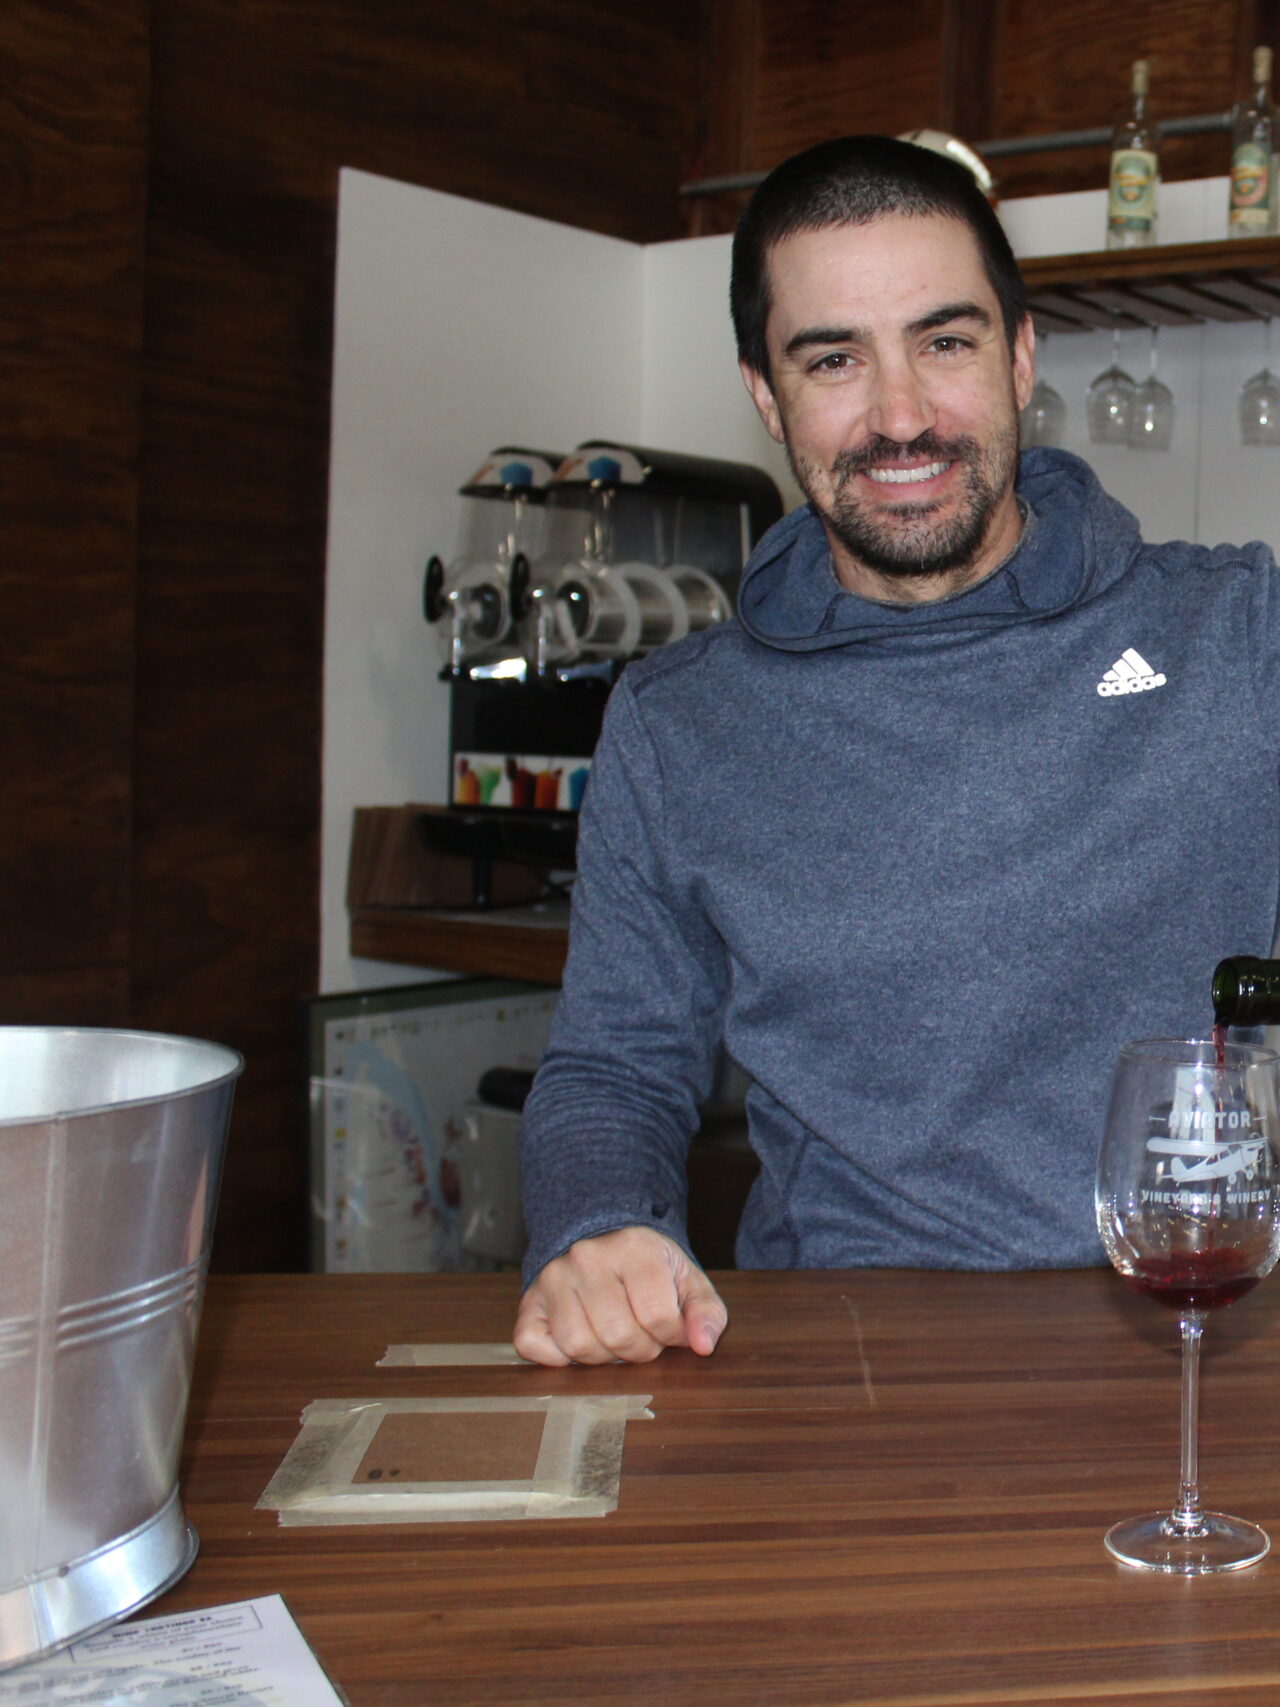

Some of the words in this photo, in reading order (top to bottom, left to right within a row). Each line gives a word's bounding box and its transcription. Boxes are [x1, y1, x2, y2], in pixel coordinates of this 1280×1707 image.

[1097, 672, 1167, 698] adidas
[1167, 1110, 1252, 1129] AVIATOR
[1142, 1190, 1208, 1205] VINEYARD
[1227, 1189, 1271, 1204] WINERY
